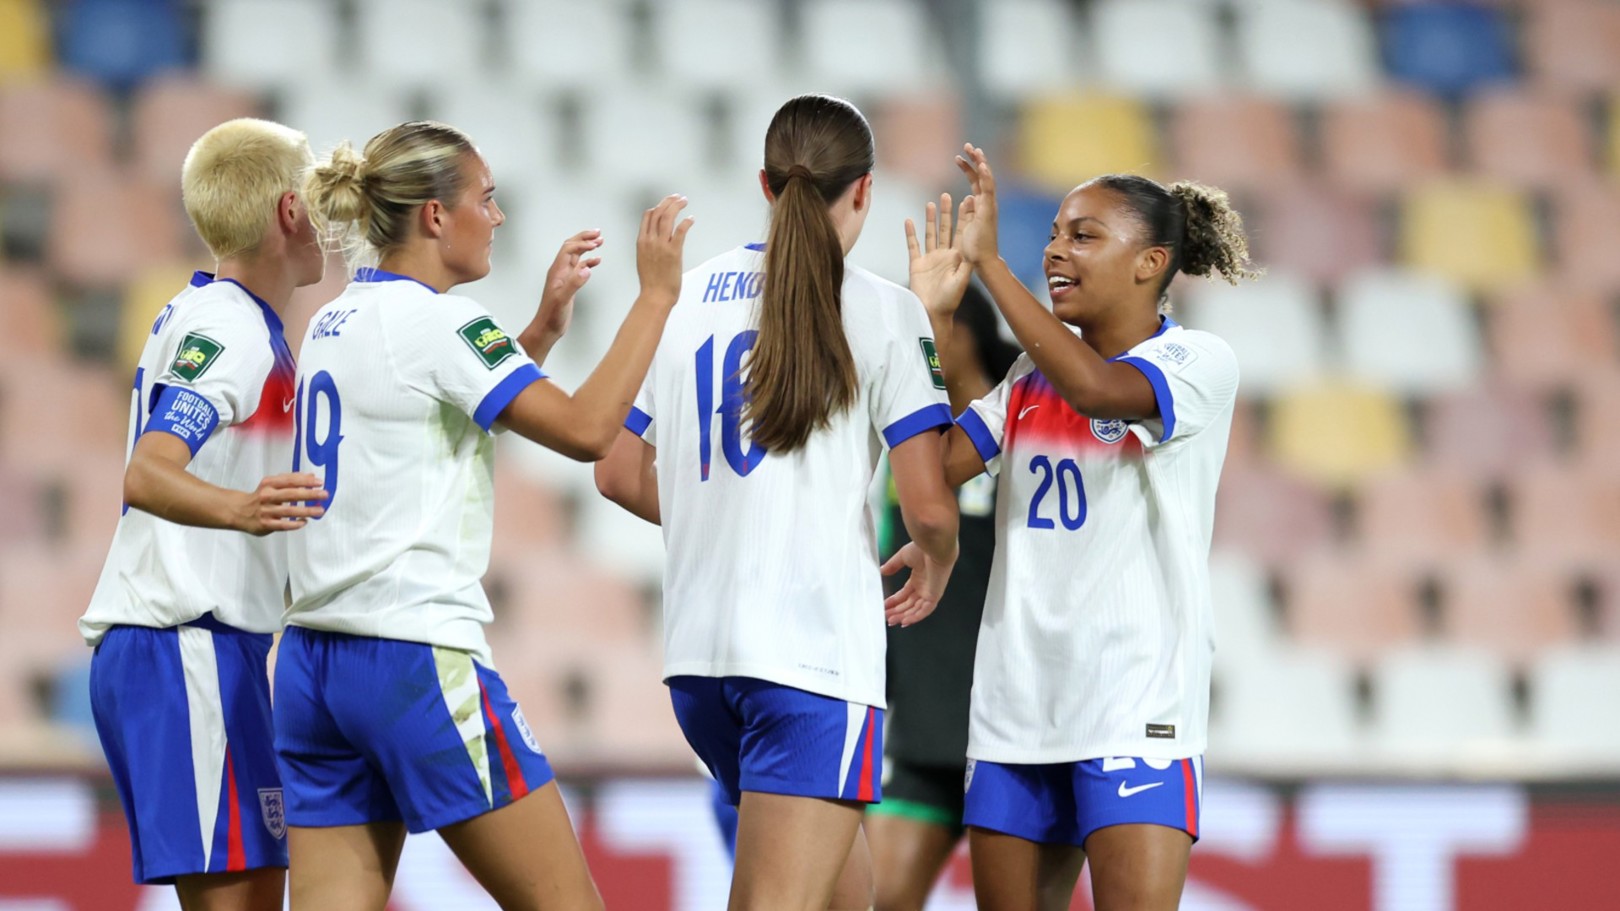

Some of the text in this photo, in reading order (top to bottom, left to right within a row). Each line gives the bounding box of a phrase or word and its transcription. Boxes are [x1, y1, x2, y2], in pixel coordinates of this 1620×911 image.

[312, 308, 358, 340] GALE
[171, 399, 210, 430] UNITES
[177, 390, 214, 420] FOOTBALL
[164, 411, 205, 441] the World
[289, 369, 345, 521] 19
[1027, 454, 1087, 531] 20
